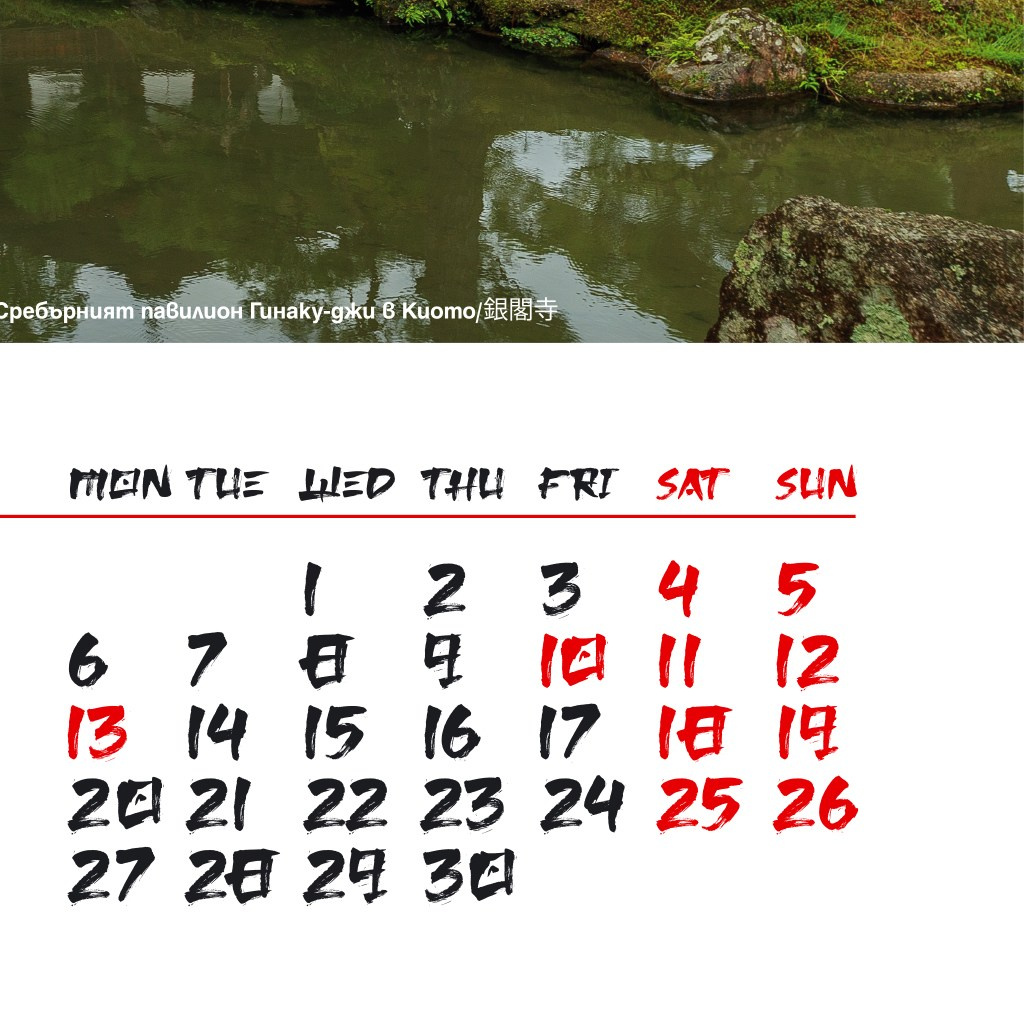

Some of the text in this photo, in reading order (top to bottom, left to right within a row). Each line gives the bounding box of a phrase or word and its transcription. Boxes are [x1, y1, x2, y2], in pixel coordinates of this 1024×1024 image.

[70, 464, 857, 502] MON TUE WED THU FRI SAT SUN
[304, 560, 819, 620] 1 2 3 4 5
[69, 632, 839, 691] 6 7 8 9 10 11 12
[68, 703, 839, 762] 13 14 15 16 17 18 19
[68, 775, 858, 834] 20 21 22 23 24 25 26
[67, 847, 517, 906] 27 28 29 30
